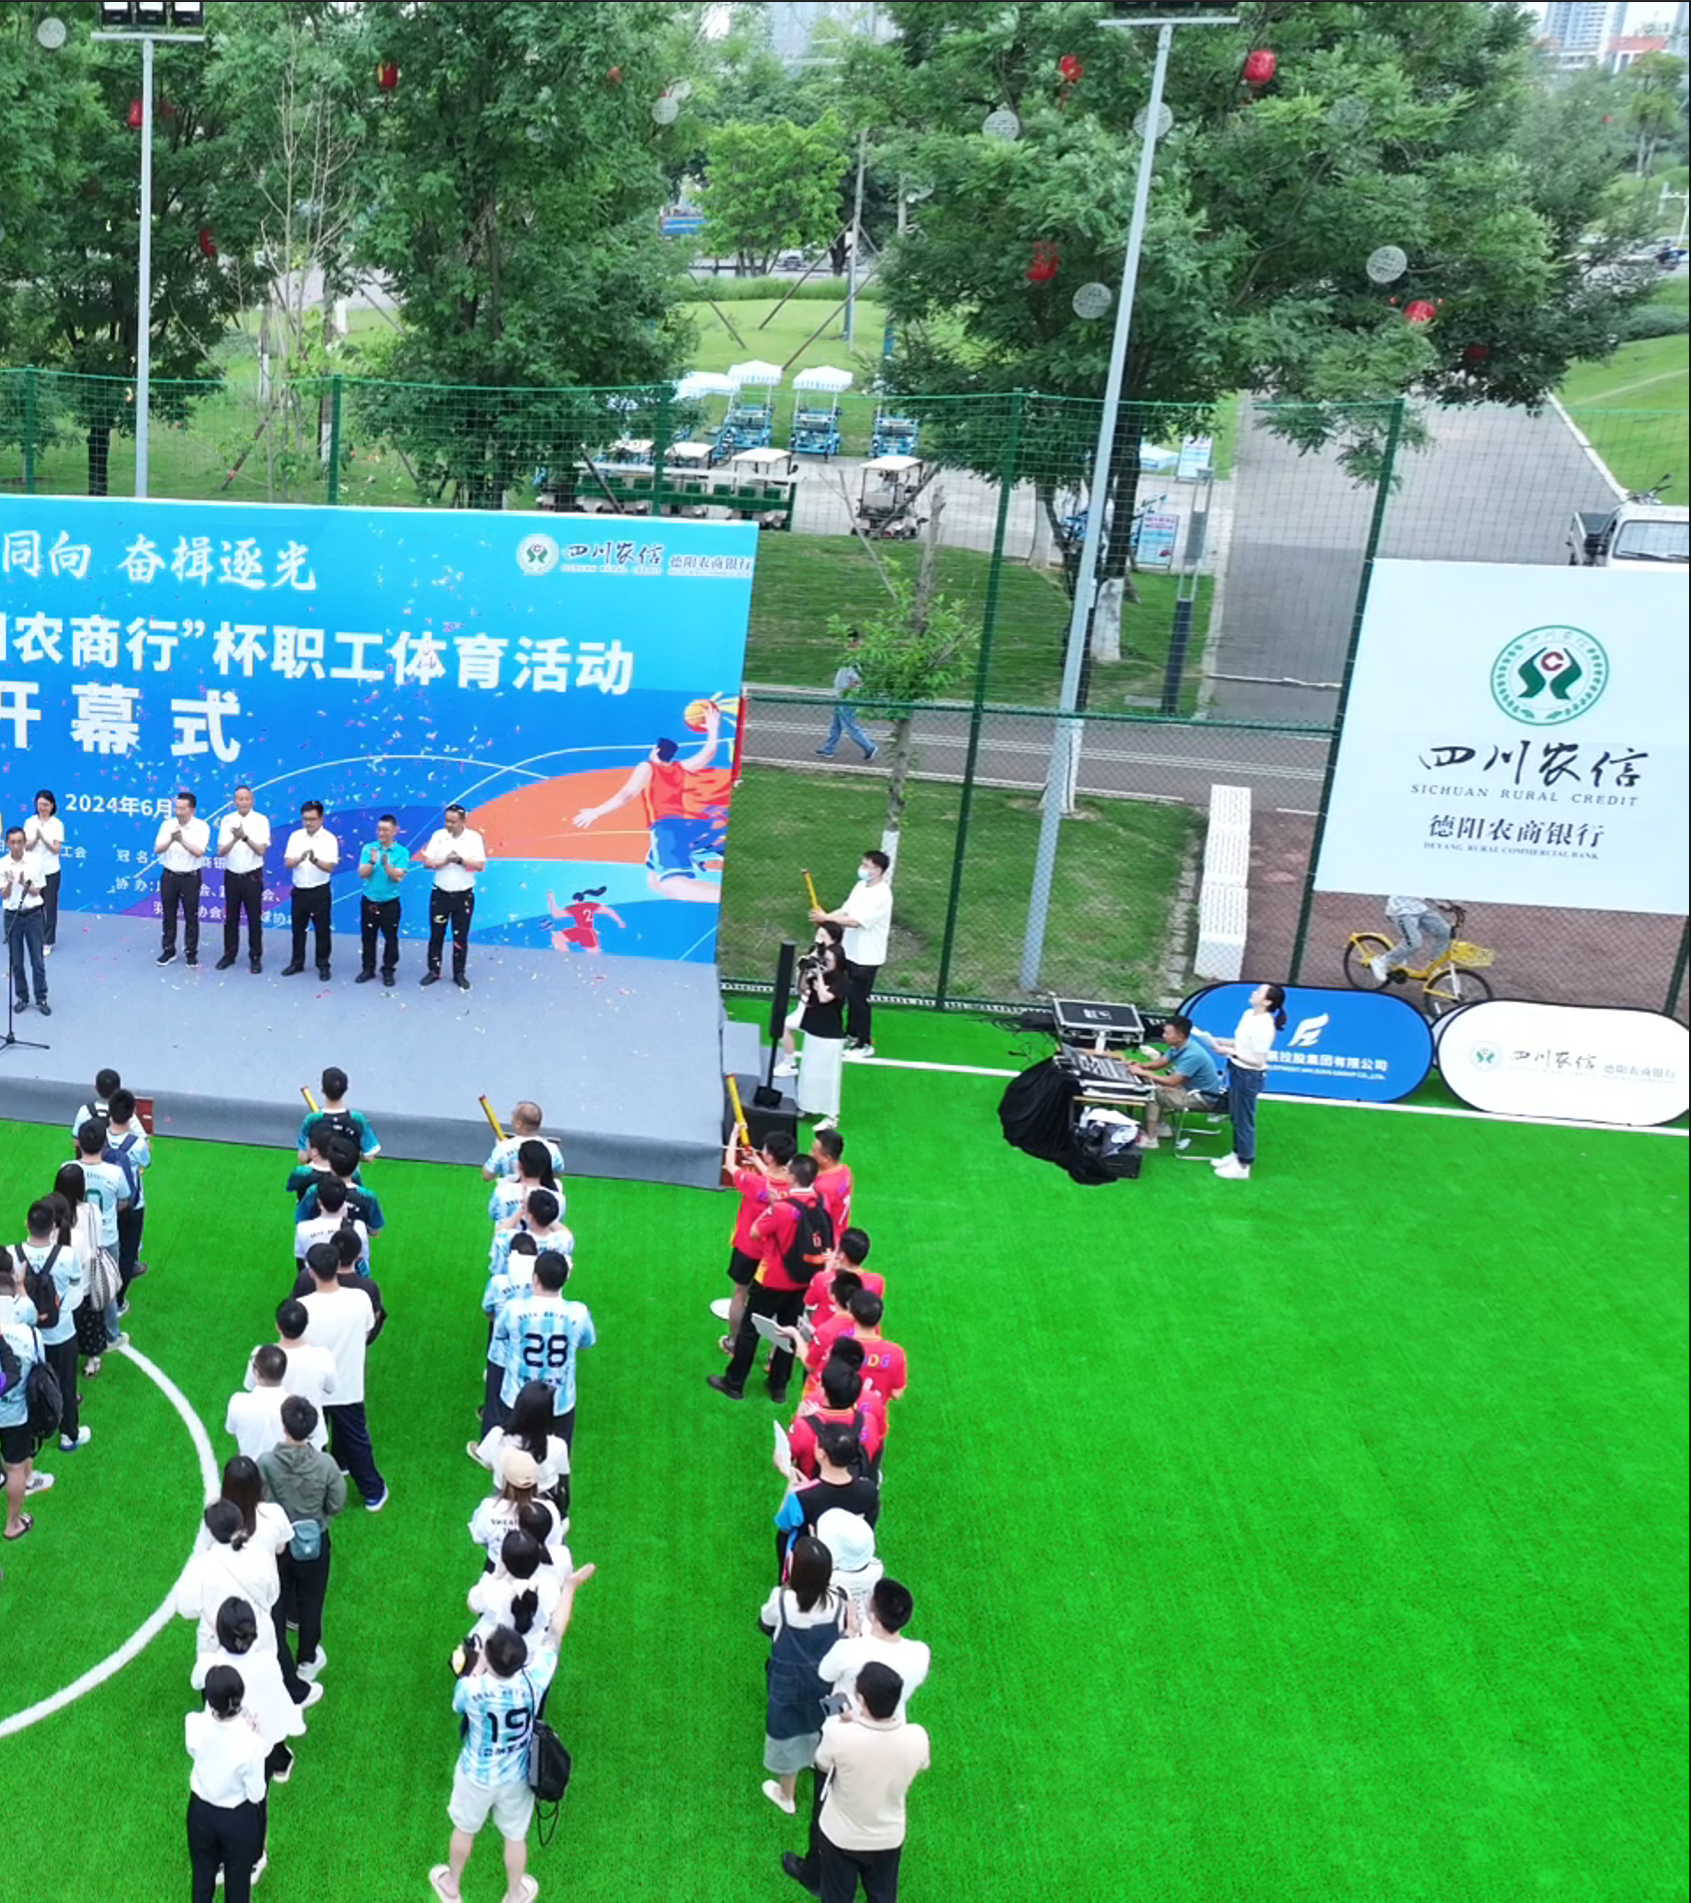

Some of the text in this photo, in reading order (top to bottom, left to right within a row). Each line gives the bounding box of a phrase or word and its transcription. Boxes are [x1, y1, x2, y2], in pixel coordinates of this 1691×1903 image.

[567, 542, 664, 565] 四川农信
[1419, 740, 1649, 788] 四川农信
[65, 793, 174, 820] 2024年6月
[1410, 783, 1638, 806] SICHUAN RURAL CREDIT
[1428, 815, 1604, 847] 德阳农商银行
[1267, 1050, 1387, 1073] 展控股集团有限公司
[523, 1332, 569, 1369] 28
[486, 1706, 532, 1744] 19
